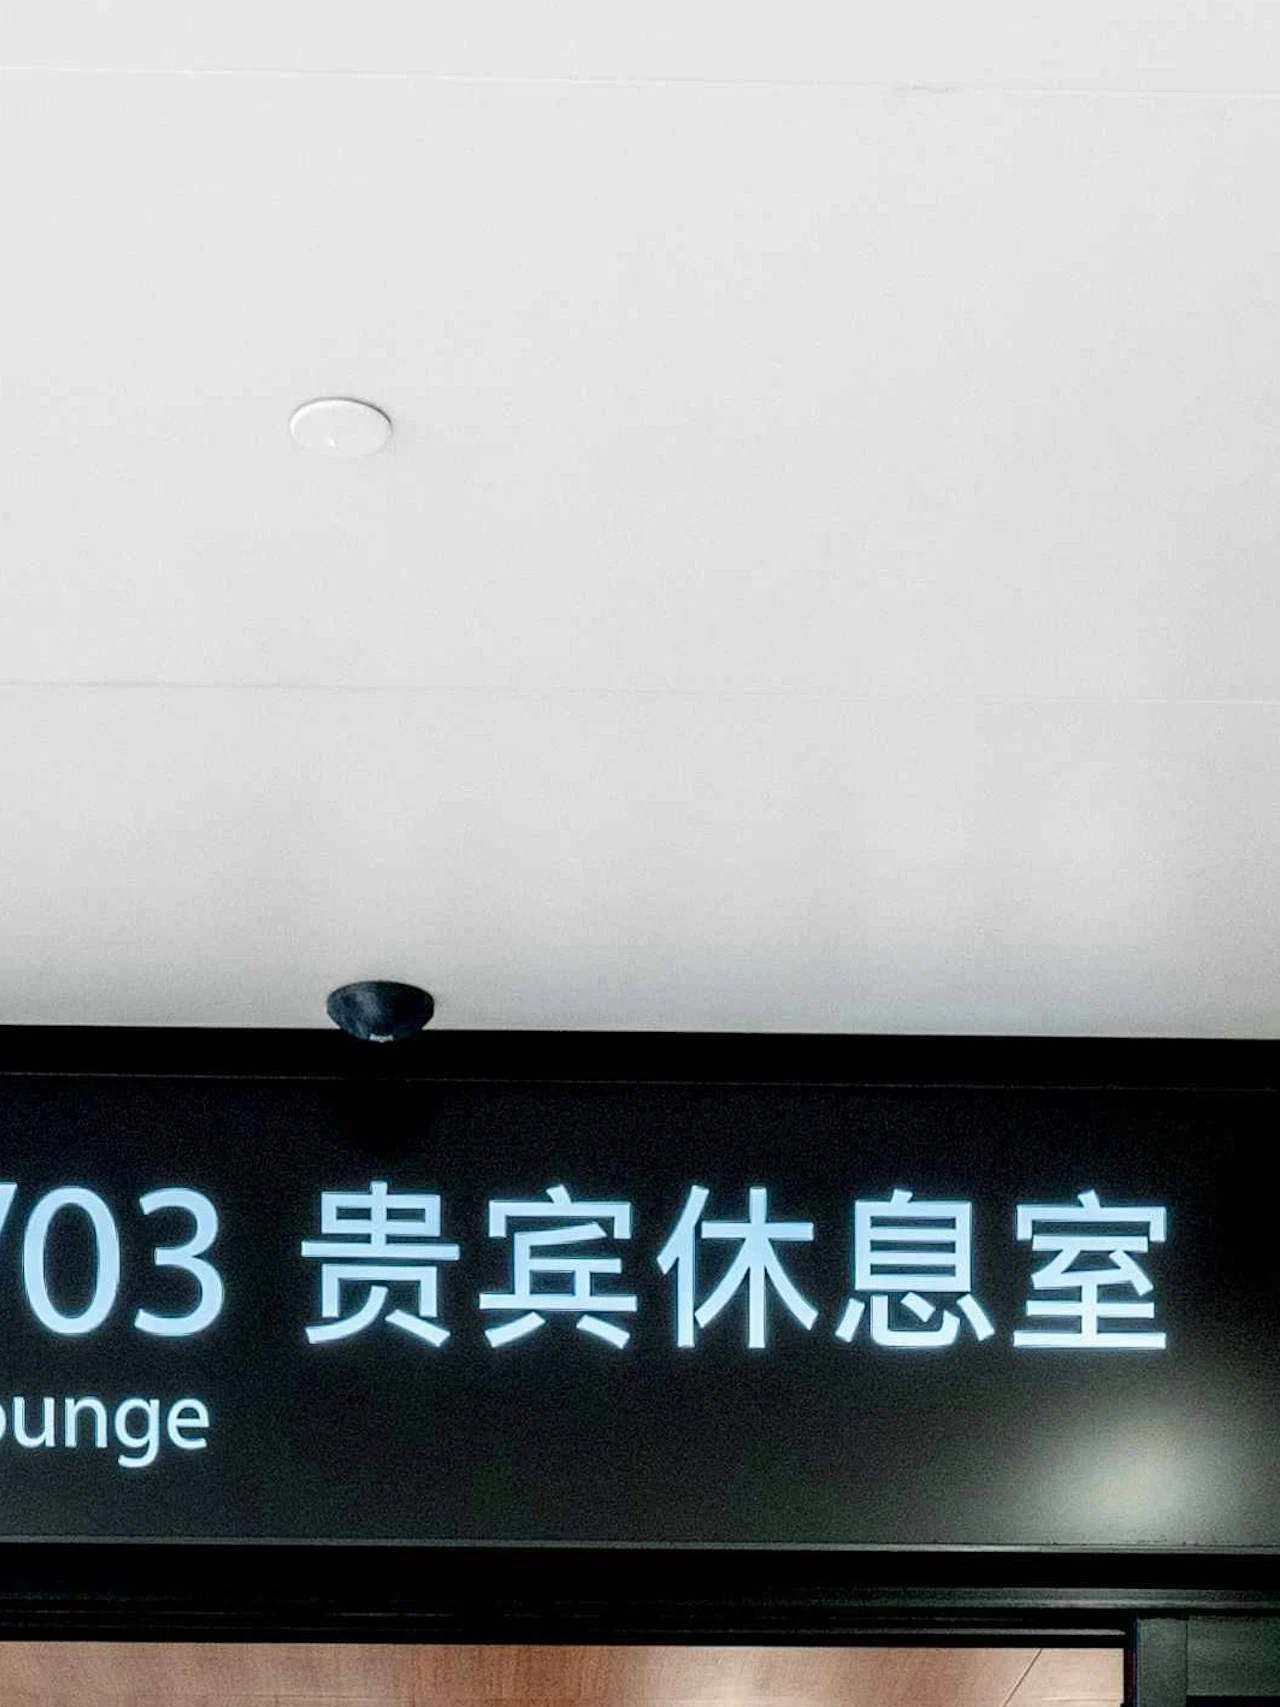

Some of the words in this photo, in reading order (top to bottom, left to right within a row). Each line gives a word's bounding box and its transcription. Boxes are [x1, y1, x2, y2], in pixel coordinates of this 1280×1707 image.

[300, 1180, 1170, 1350] 贵宾休息室
